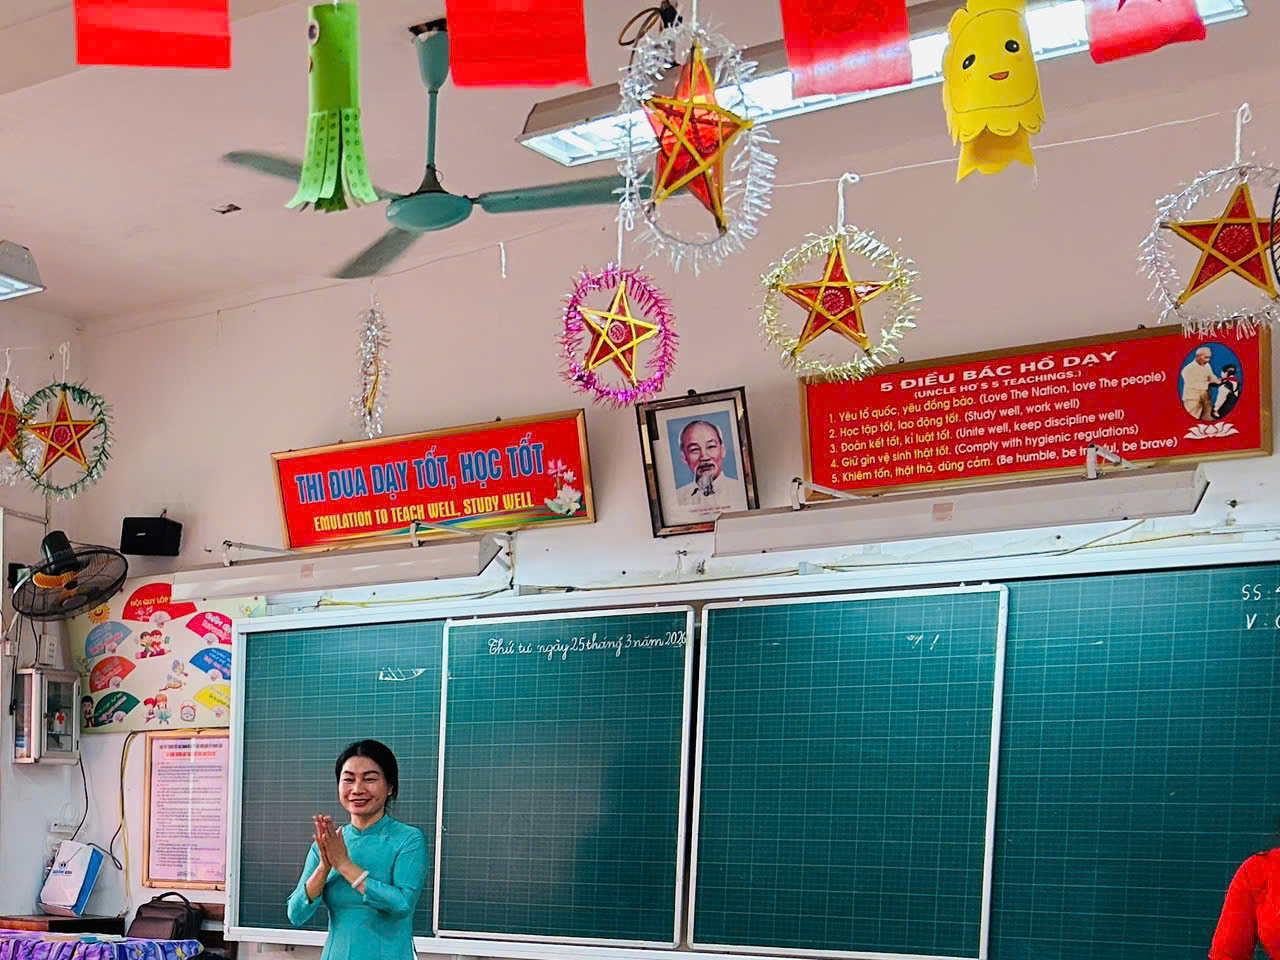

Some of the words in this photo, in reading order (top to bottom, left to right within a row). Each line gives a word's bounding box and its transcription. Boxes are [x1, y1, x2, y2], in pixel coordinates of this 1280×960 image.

[880, 382, 894, 391] 5
[900, 371, 955, 389] ĐIỀU
[962, 365, 1012, 381] BÁC
[1020, 355, 1055, 373] HỒ
[1063, 351, 1118, 367] DẠY
[914, 386, 957, 398] (UNCLE
[829, 413, 836, 424] 1.
[839, 411, 857, 422] Yêu
[871, 405, 900, 419] quốc,
[902, 402, 921, 416] yêu
[979, 392, 1008, 405] (Love
[1010, 389, 1029, 399] The
[1031, 384, 1070, 397] Nation,
[1072, 381, 1096, 392] love
[1099, 377, 1118, 388] The
[1121, 371, 1166, 388] people)
[829, 428, 837, 438] 2.
[840, 427, 859, 438] Học
[861, 424, 878, 436] tập
[898, 420, 914, 430] lao
[916, 417, 943, 429] động
[964, 409, 996, 422] (Study
[999, 405, 1023, 417] well,
[1026, 401, 1051, 413] work
[1054, 398, 1080, 410] well)
[829, 443, 838, 454] 3.
[841, 440, 866, 452] Đoàn
[869, 437, 884, 449] kết
[956, 426, 985, 439] (Unite
[988, 422, 1011, 434] well,
[1014, 420, 1042, 431] keep
[1044, 414, 1096, 427] discipline
[1098, 409, 1125, 421] well)
[830, 458, 839, 468] 4.
[877, 452, 890, 465] vệ
[892, 450, 912, 461] sinh
[914, 447, 933, 460] thật
[954, 440, 999, 455] (Comply
[1001, 437, 1023, 449] with
[1025, 432, 1071, 447] hygienic
[1074, 423, 1139, 441] regulations)
[294, 472, 325, 504] THI
[328, 467, 368, 500] ĐUA
[370, 461, 408, 500] DẠY
[412, 445, 457, 489] TỐT,
[459, 447, 503, 489] HỌC
[505, 431, 544, 478] TỐT
[831, 473, 840, 483] 5.
[842, 470, 872, 482] Khiêm
[996, 454, 1013, 466] (Be
[1016, 450, 1059, 463] humble,
[1062, 448, 1077, 458] be
[1122, 441, 1138, 452] be
[1140, 436, 1178, 450] brave)
[313, 510, 373, 531] EMULATION
[374, 508, 389, 525] TO
[391, 504, 425, 523] TEACH
[427, 500, 461, 519] WELL,
[463, 495, 499, 515] STUDY
[502, 491, 535, 510] WELL
[487, 638, 515, 655] Thứ
[537, 639, 569, 660] ngày
[570, 636, 585, 651] 25
[585, 632, 624, 657] tháng
[625, 634, 632, 648] 3
[632, 636, 664, 648] năm
